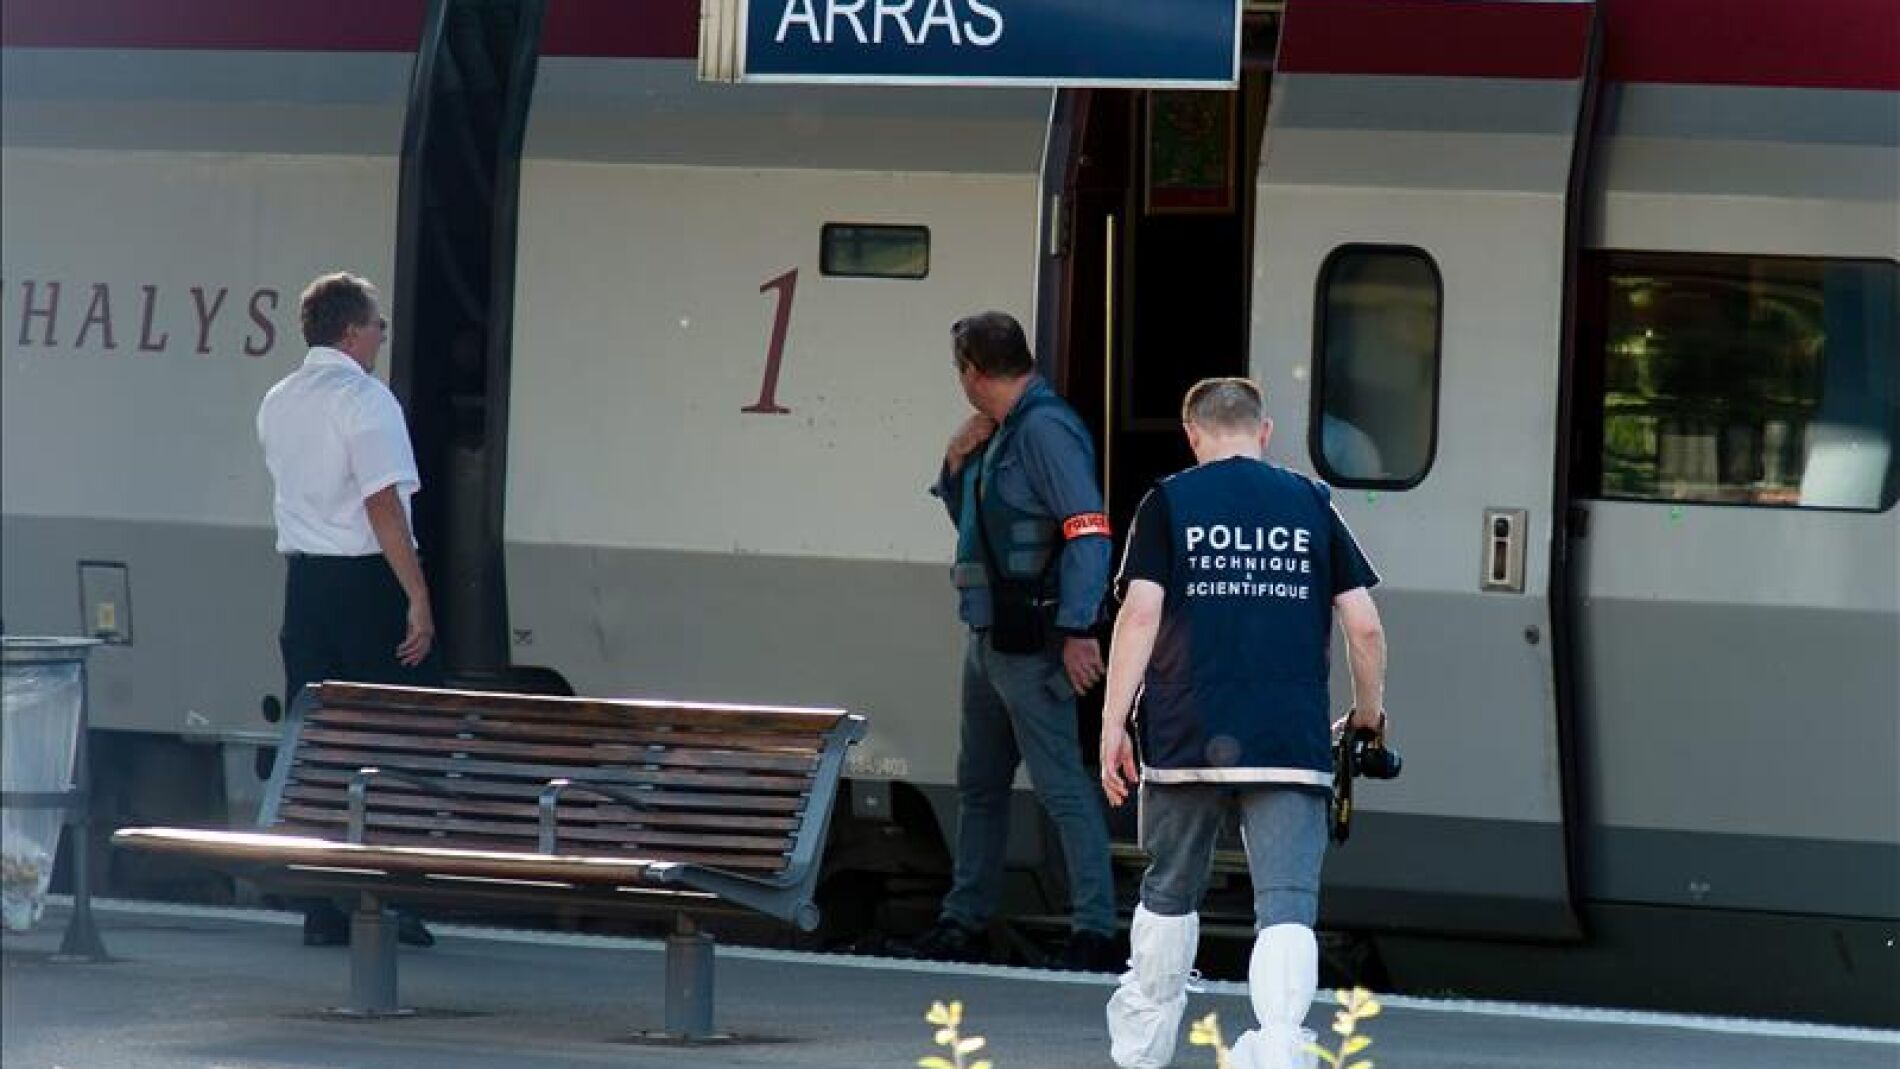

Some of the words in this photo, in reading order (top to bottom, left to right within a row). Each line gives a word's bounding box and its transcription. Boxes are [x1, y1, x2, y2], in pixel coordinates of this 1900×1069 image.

[775, 0, 1004, 46] ARRAS
[0, 279, 279, 357] HALYS
[740, 267, 799, 414] 1
[1186, 525, 1311, 552] POLICE
[1188, 555, 1311, 573] TECHNIQUE
[1186, 581, 1310, 599] SCIENTIFIQUE
